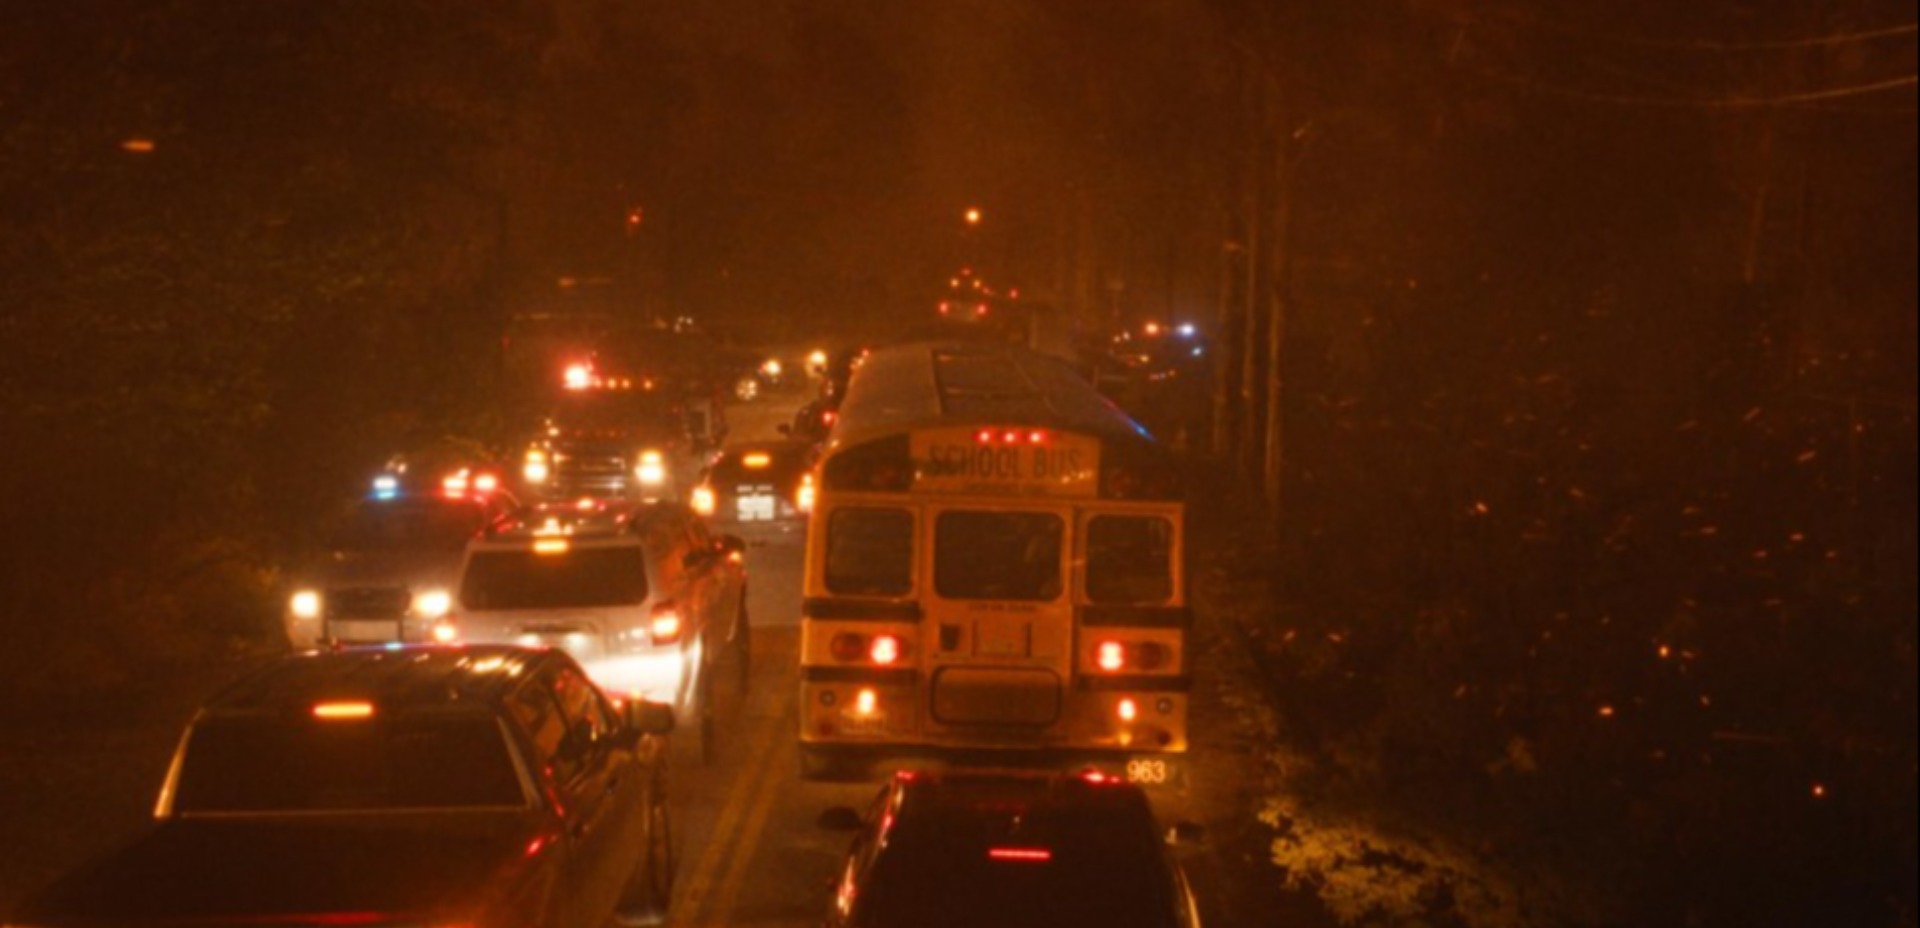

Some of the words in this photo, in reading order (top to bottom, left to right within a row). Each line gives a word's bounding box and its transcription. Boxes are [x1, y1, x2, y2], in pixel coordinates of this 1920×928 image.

[930, 444, 1023, 478] SCHOOL
[1034, 446, 1082, 480] BUS
[1126, 760, 1166, 783] 963
